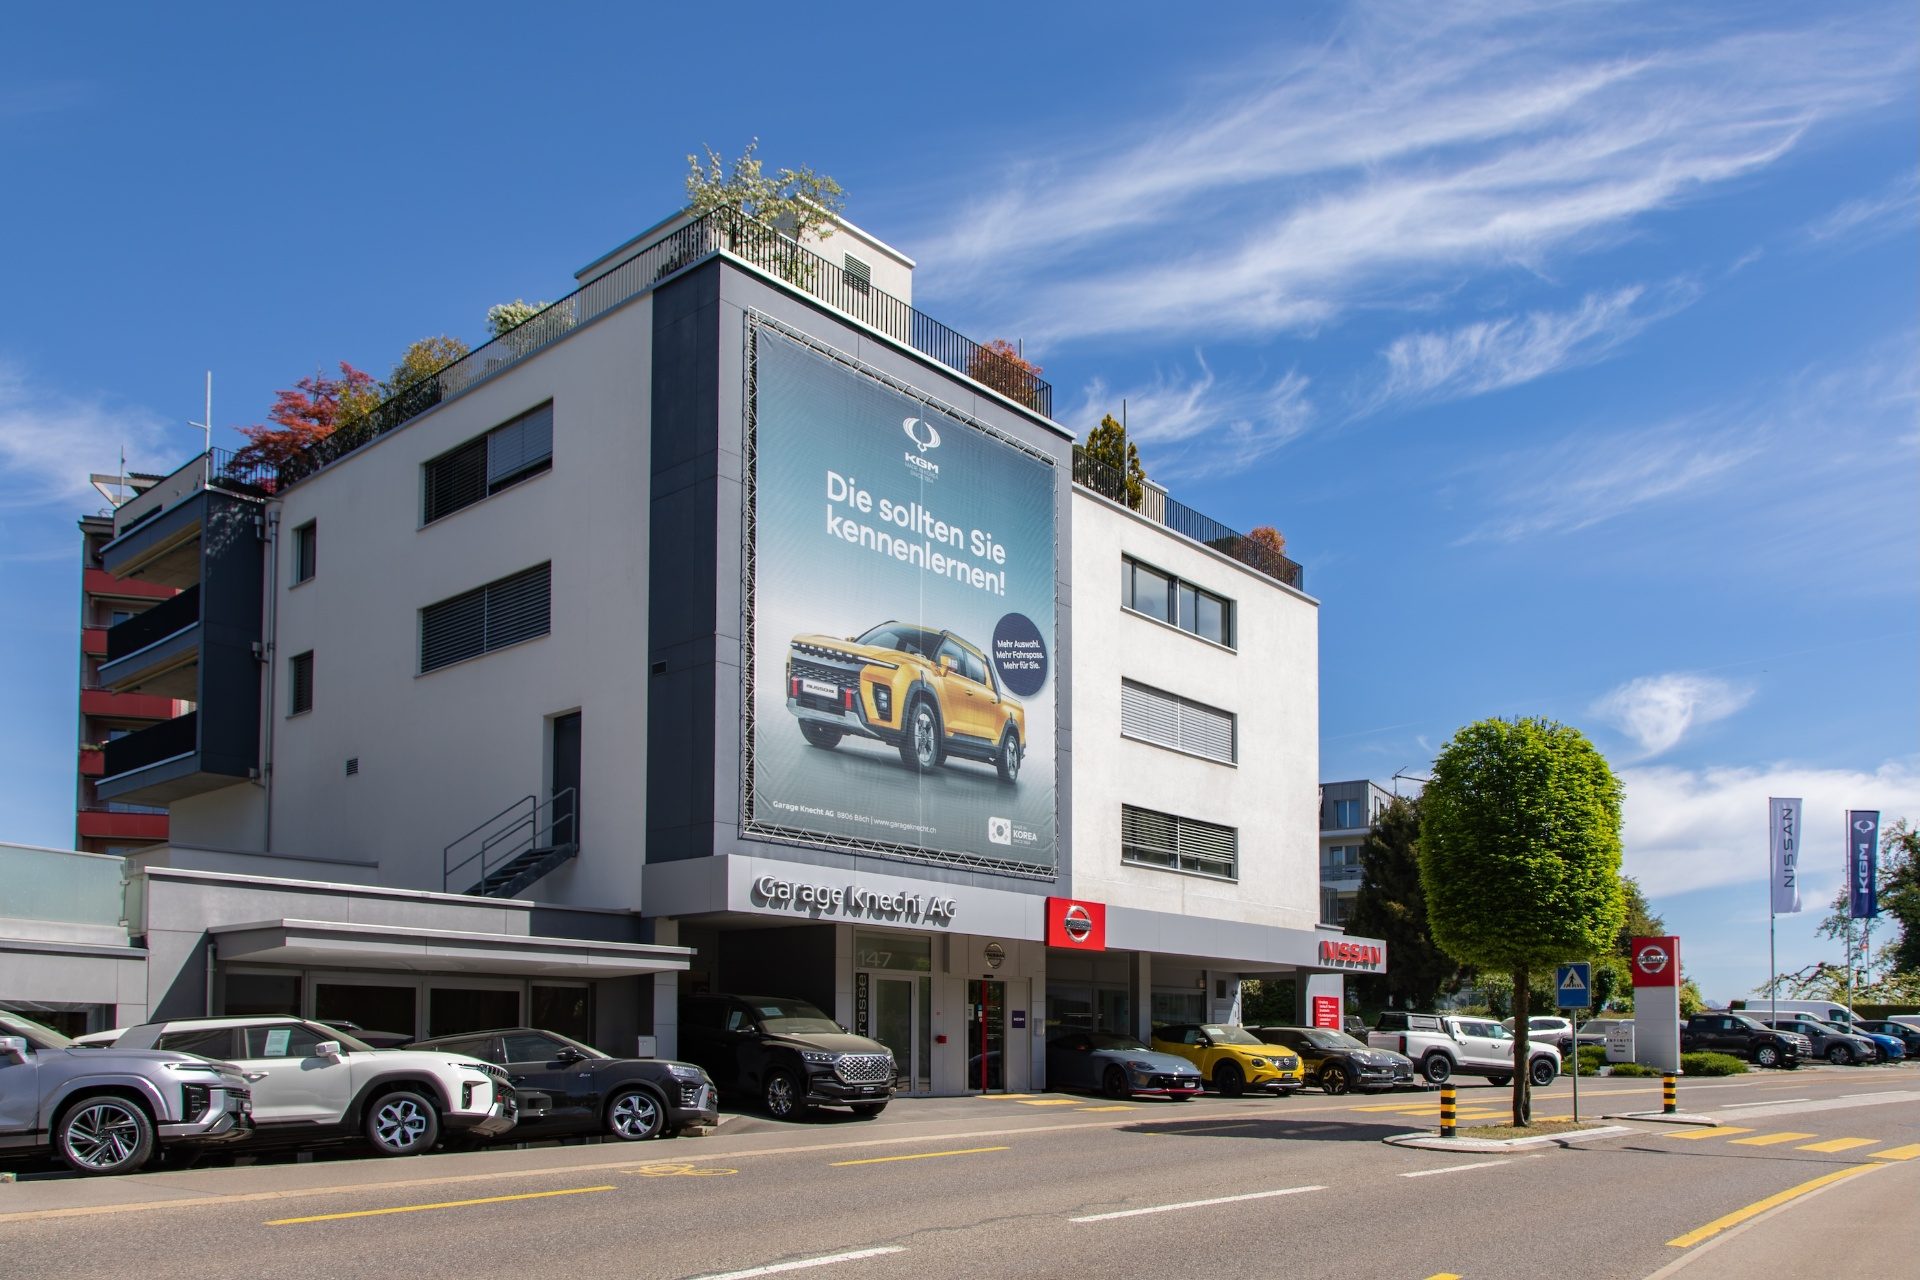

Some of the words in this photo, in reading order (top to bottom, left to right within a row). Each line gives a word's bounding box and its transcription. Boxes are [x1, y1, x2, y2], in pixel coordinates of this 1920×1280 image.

[905, 452, 939, 474] KGM
[827, 470, 872, 513] Die
[879, 499, 964, 550] sollten
[970, 529, 1006, 565] Sie
[826, 504, 1005, 597] kennenlernen!
[996, 651, 1012, 659] Mehr
[1012, 650, 1044, 661] Fahrspass.
[997, 640, 1013, 648] Mehr
[1014, 640, 1041, 648] Auswahl.
[1003, 661, 1019, 669] Mehr
[1020, 661, 1029, 669] für
[1030, 661, 1041, 669] Sie.
[773, 801, 799, 812] Garage
[800, 805, 824, 815] Knecht
[825, 809, 834, 817] AG
[836, 812, 853, 821] 8806
[874, 818, 937, 834] www.garageknecht.ch
[1013, 829, 1038, 841] KOREA
[1783, 808, 1795, 888] NISSAN
[1859, 843, 1869, 894] KGM
[758, 876, 844, 909] Garage
[851, 886, 925, 915] Knecht
[929, 896, 957, 918] AG
[858, 949, 892, 968] 147
[1322, 940, 1381, 964] NISSAN
